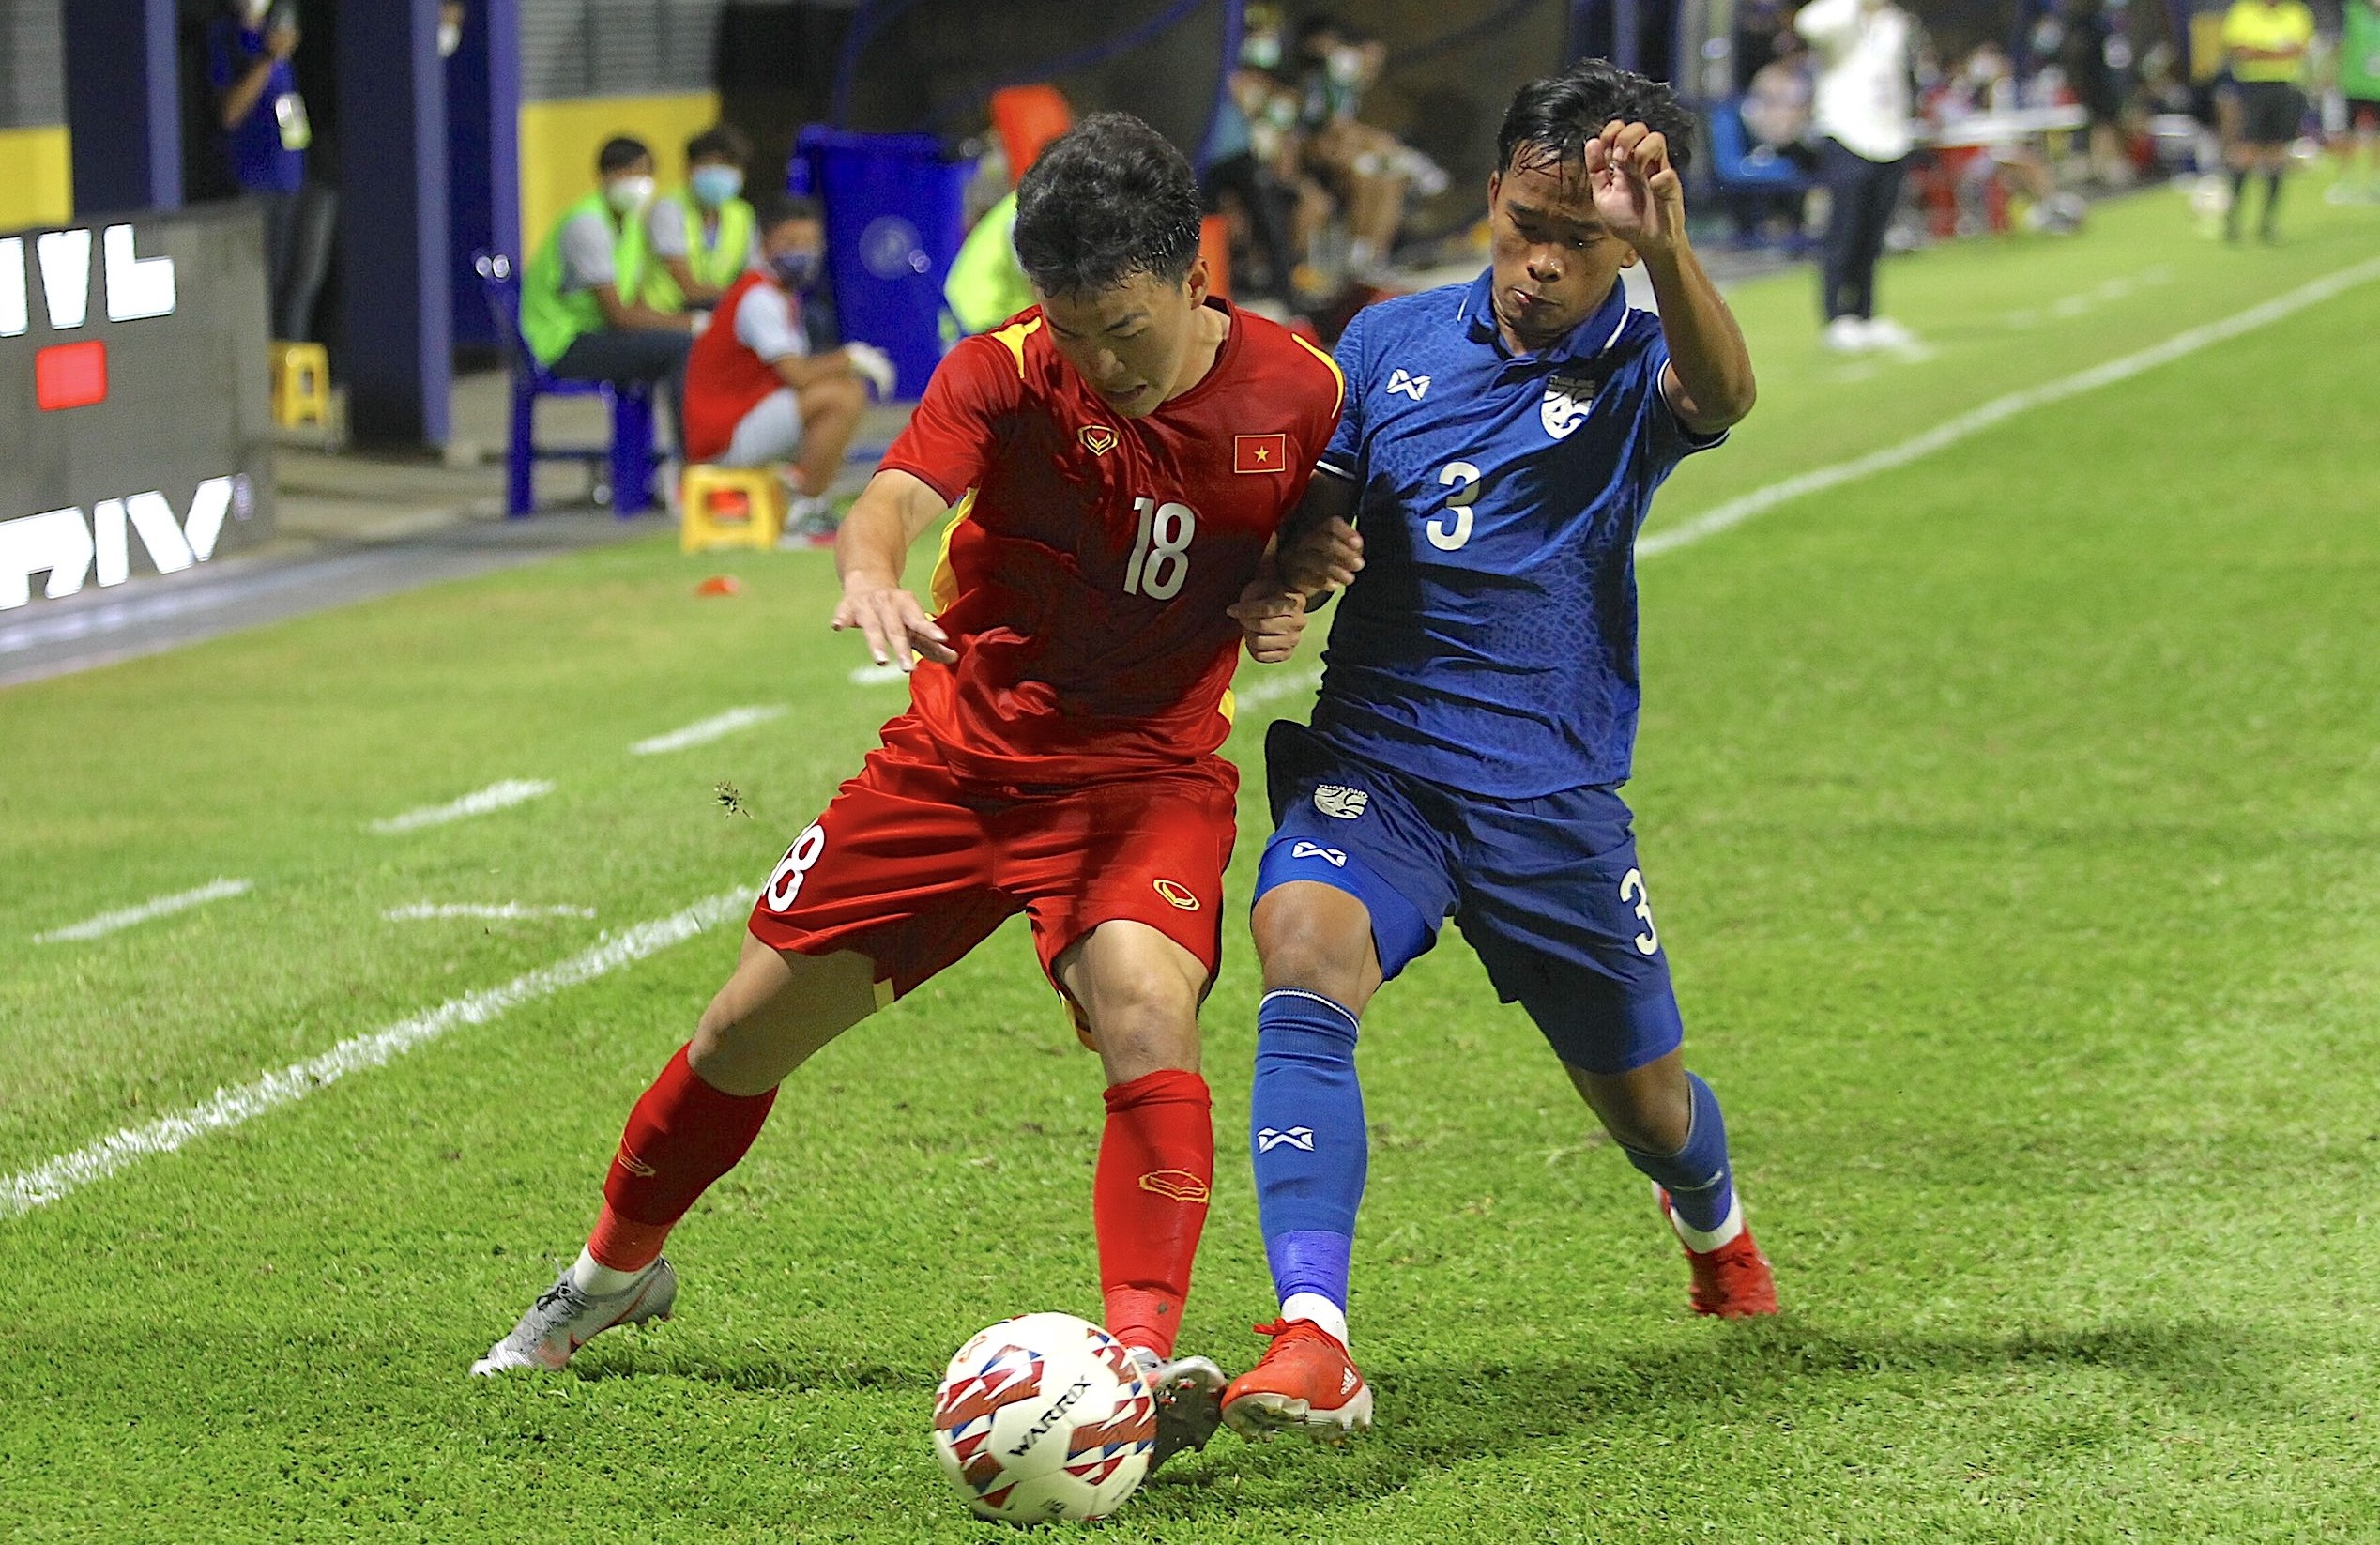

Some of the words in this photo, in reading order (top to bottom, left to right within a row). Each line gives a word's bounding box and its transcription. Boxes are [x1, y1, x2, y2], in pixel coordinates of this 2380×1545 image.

[1123, 497, 1196, 600] 18
[1426, 461, 1481, 551] 3
[762, 818, 825, 913] 8
[1620, 867, 1657, 955] 3
[1007, 1374, 1093, 1456] WARRIX
